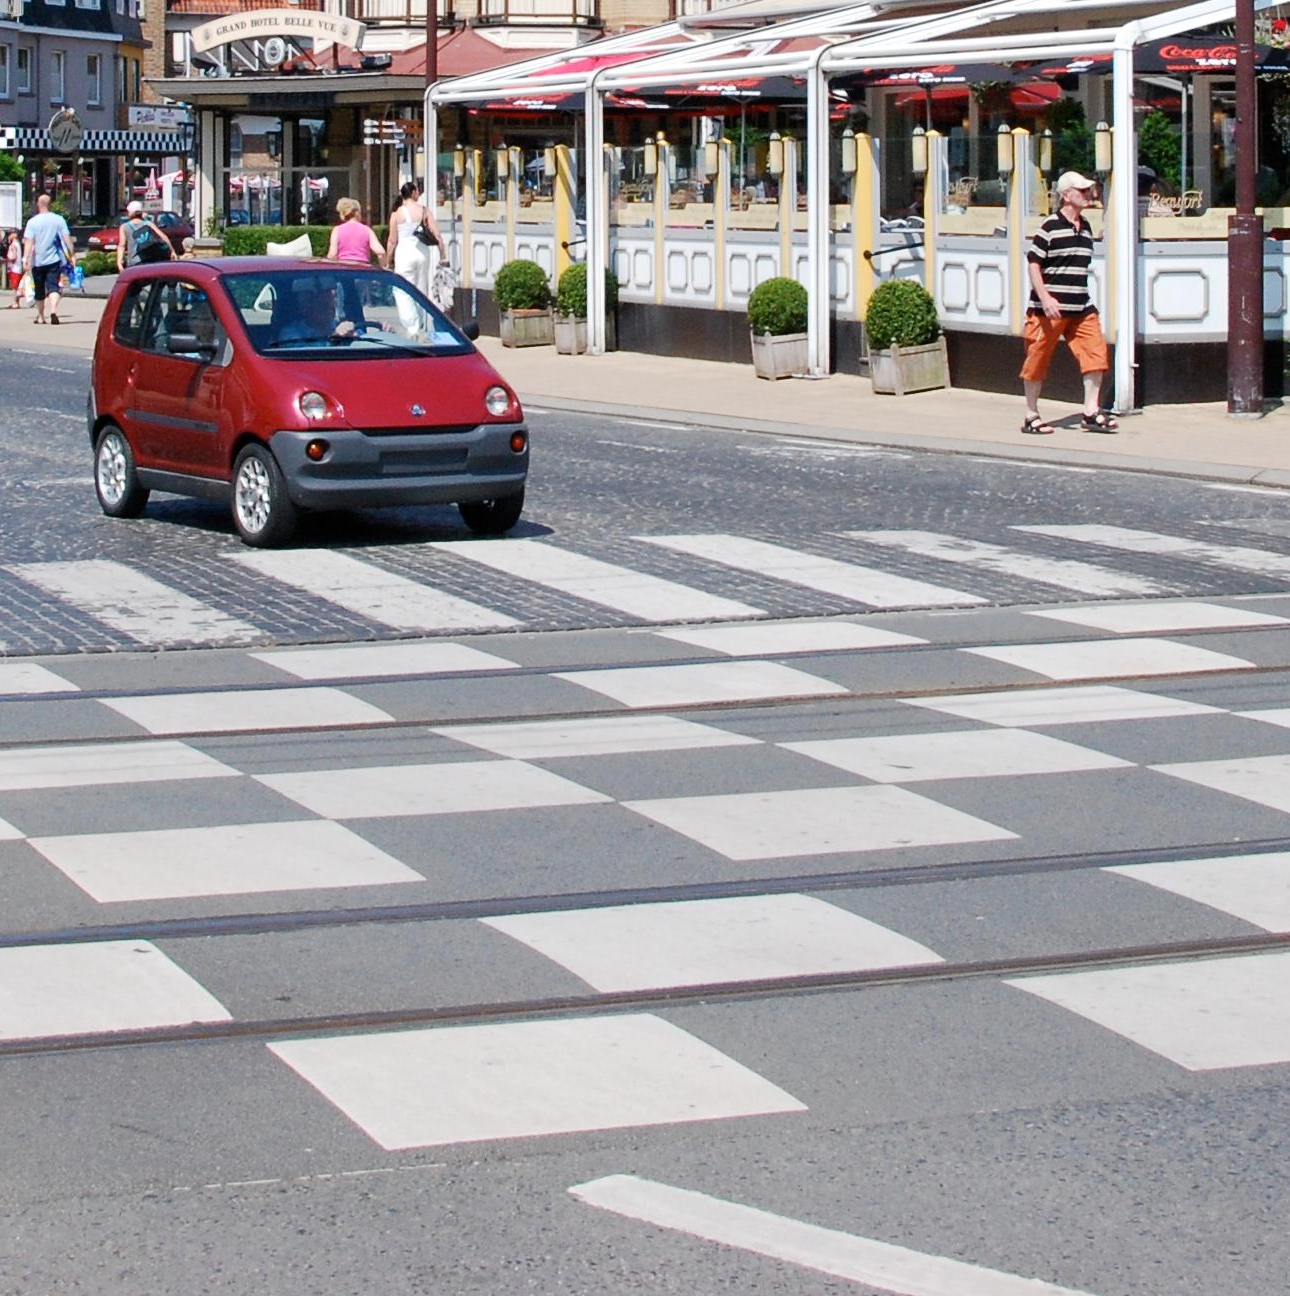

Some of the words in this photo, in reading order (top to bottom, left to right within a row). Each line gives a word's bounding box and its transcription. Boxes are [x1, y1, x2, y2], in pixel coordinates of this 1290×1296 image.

[216, 19, 247, 36] GRAND
[250, 17, 280, 28] HOTEL
[284, 16, 314, 28] BELLE
[318, 20, 337, 32] VUE
